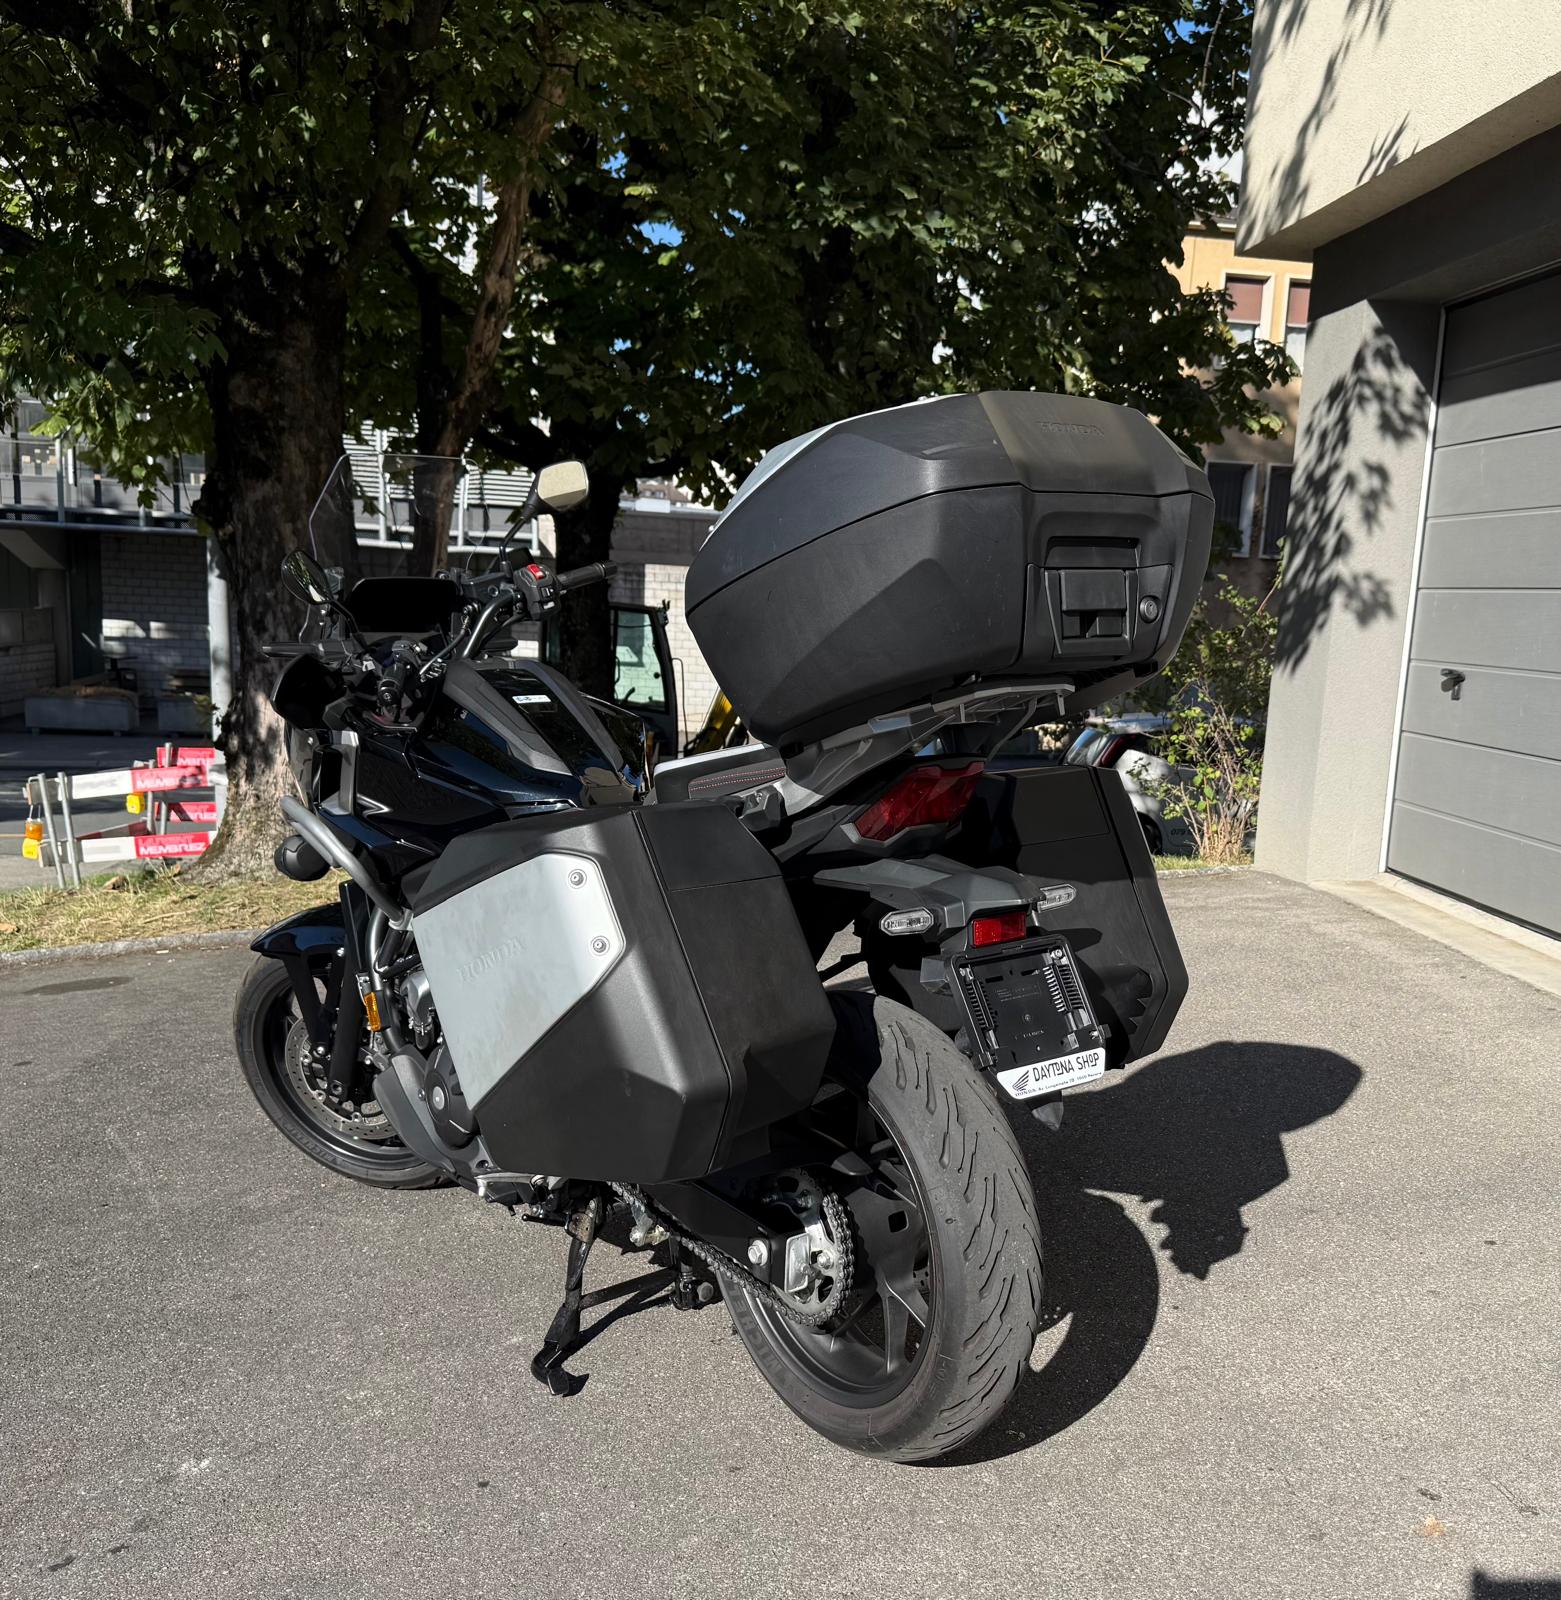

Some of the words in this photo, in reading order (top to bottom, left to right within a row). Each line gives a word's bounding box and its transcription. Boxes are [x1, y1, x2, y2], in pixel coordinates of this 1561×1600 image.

[139, 842, 206, 855] MEMBREZ
[455, 935, 525, 982] HONDA
[1032, 1059, 1075, 1082] DAYTONA
[1076, 1052, 1100, 1070] SHOP
